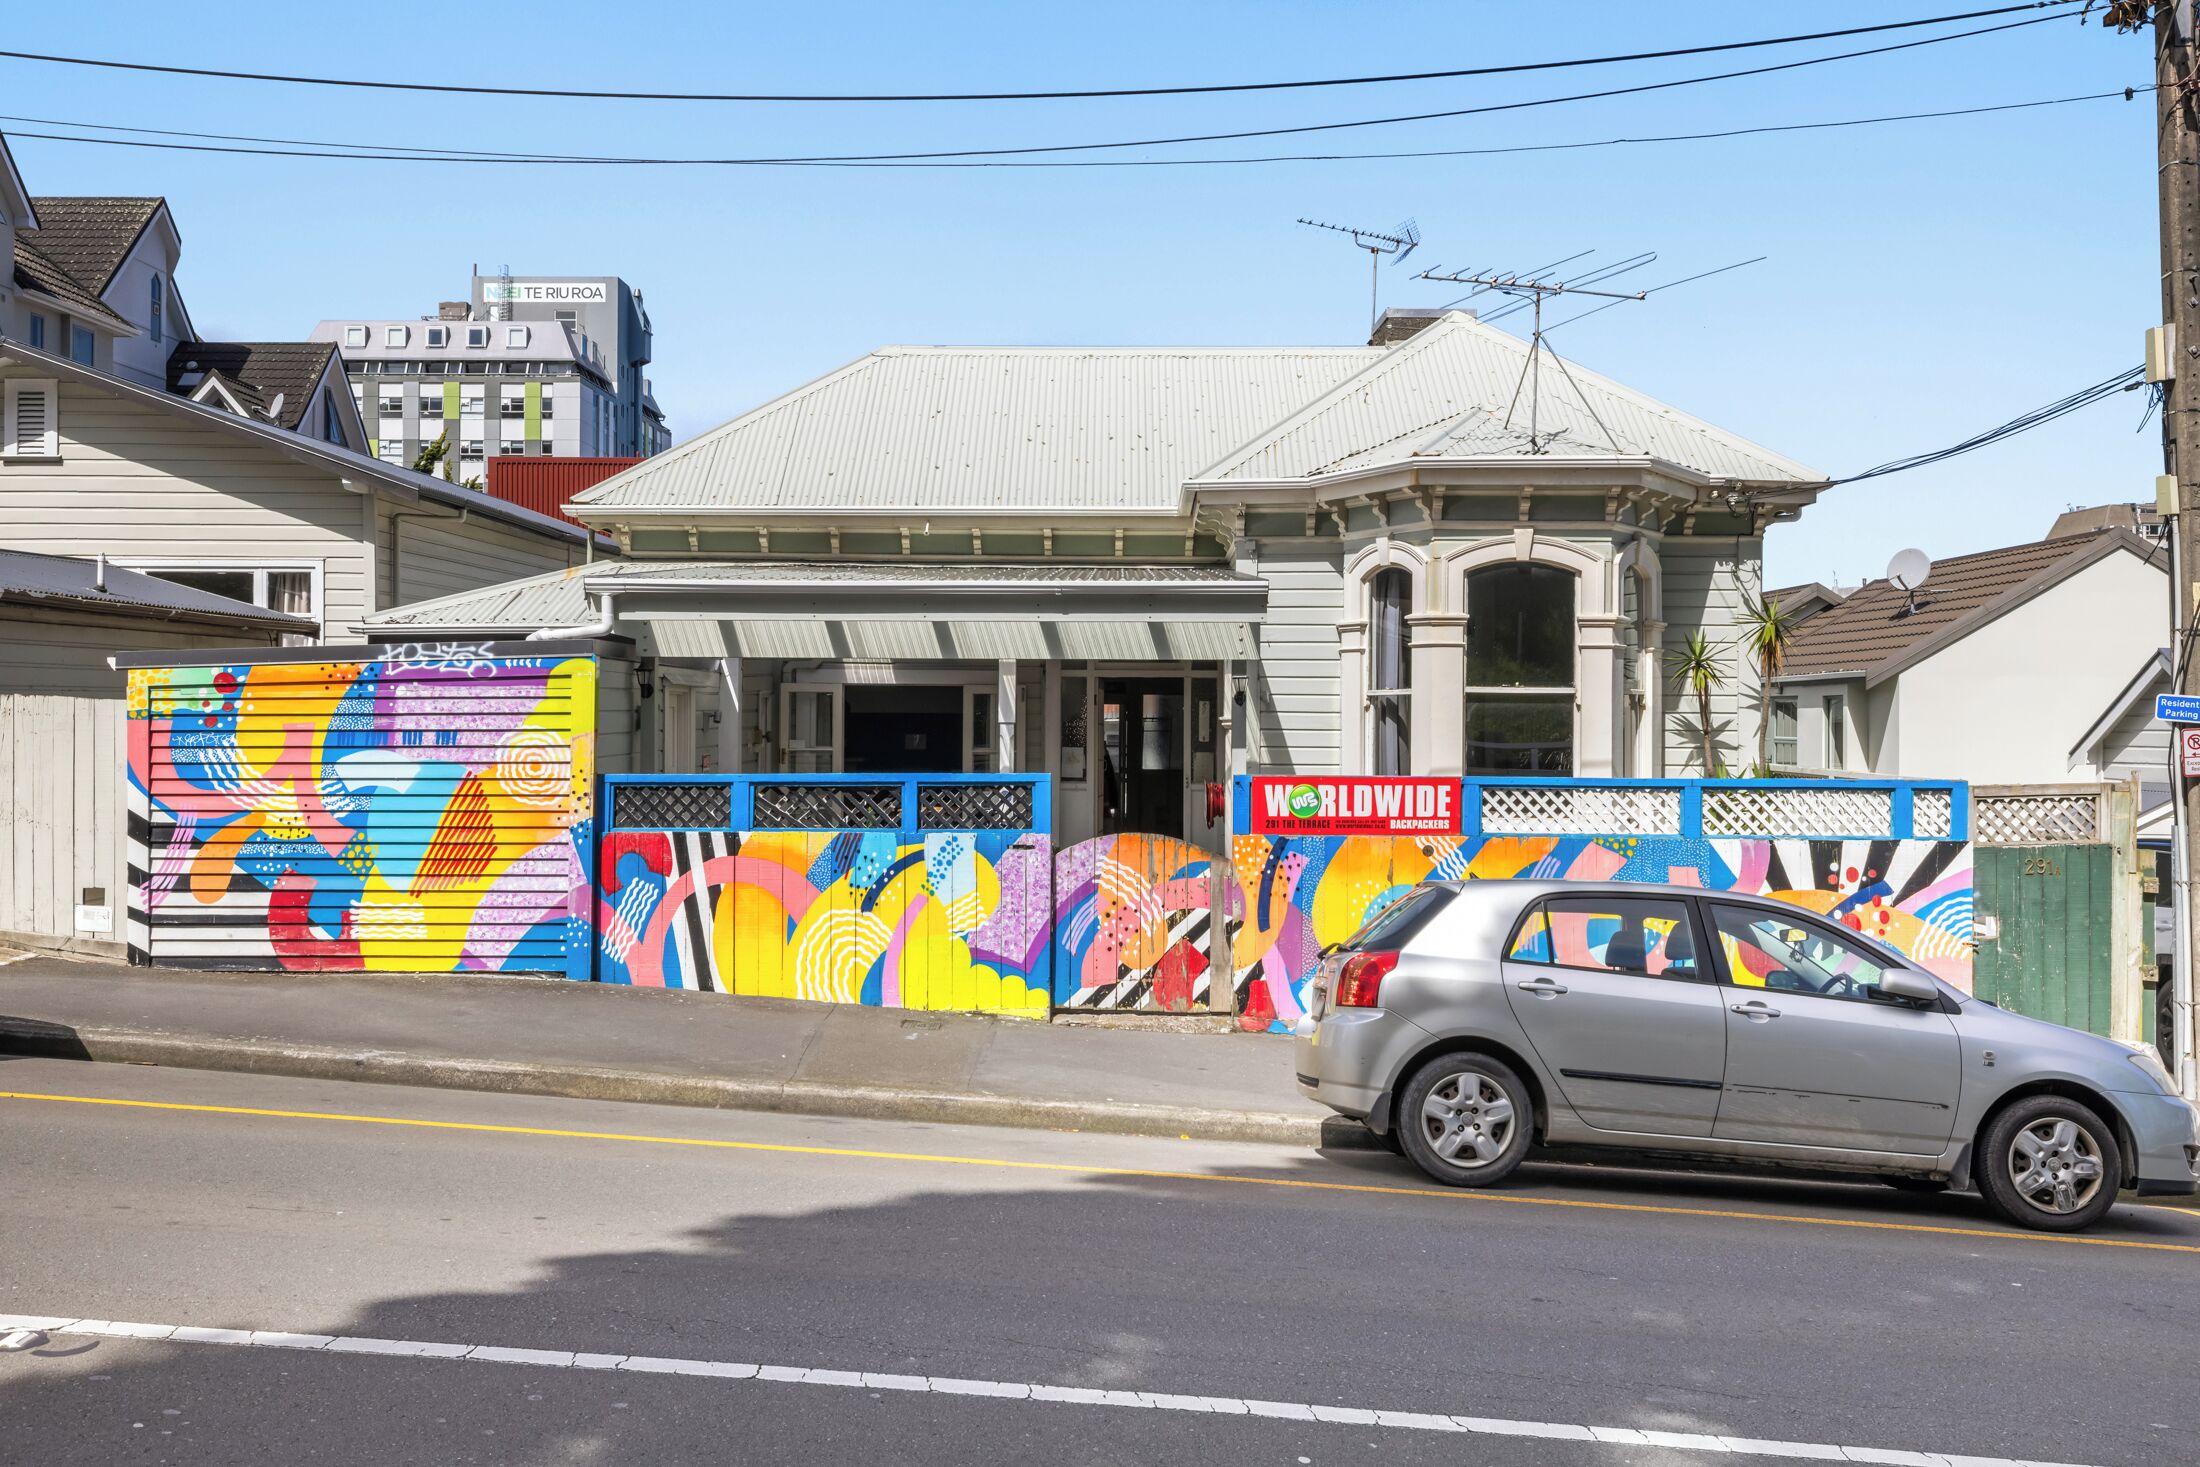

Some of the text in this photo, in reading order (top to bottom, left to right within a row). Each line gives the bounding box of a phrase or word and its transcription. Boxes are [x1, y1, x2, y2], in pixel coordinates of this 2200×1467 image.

[524, 287, 542, 299] TE
[546, 287, 569, 299] RIU
[572, 287, 603, 299] ROA
[2165, 709, 2198, 719] Parking
[1265, 819, 1280, 829] 291
[1283, 819, 1296, 829] THE
[1299, 819, 1331, 829] TERRACE
[1390, 819, 1450, 830] BACKPACKERS
